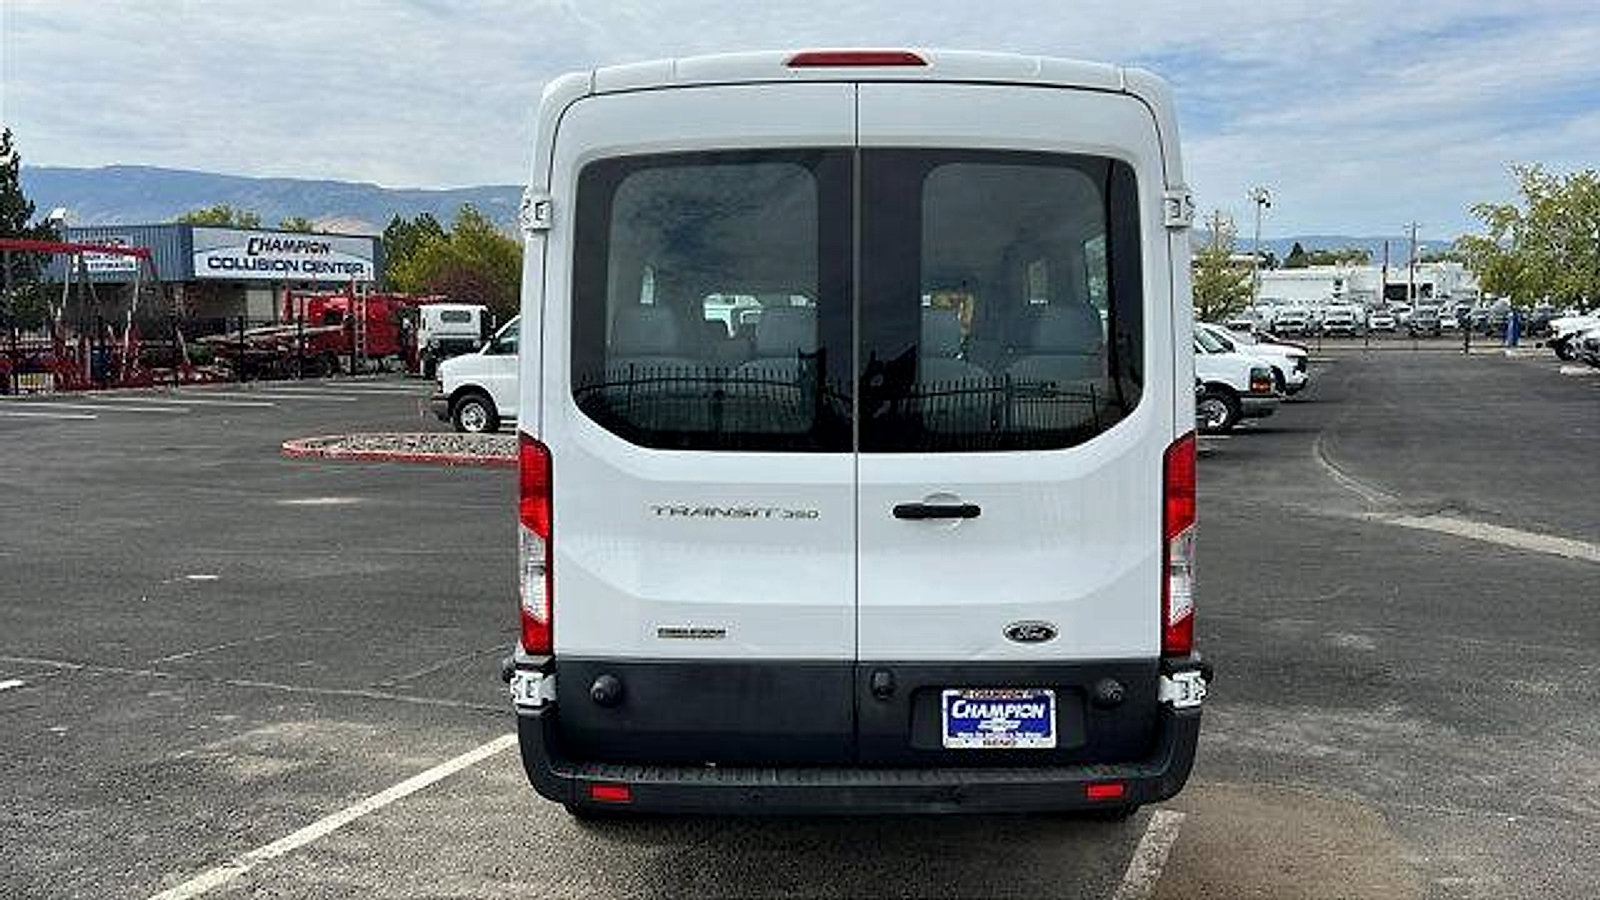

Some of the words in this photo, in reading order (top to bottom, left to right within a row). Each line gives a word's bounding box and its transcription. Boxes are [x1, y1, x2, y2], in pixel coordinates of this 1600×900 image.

[248, 237, 331, 256] CHAMPION
[207, 256, 299, 272] COLLISION
[302, 260, 364, 274] CENTER
[650, 504, 780, 518] TRANSIT
[951, 700, 1046, 719] CHAMPION
